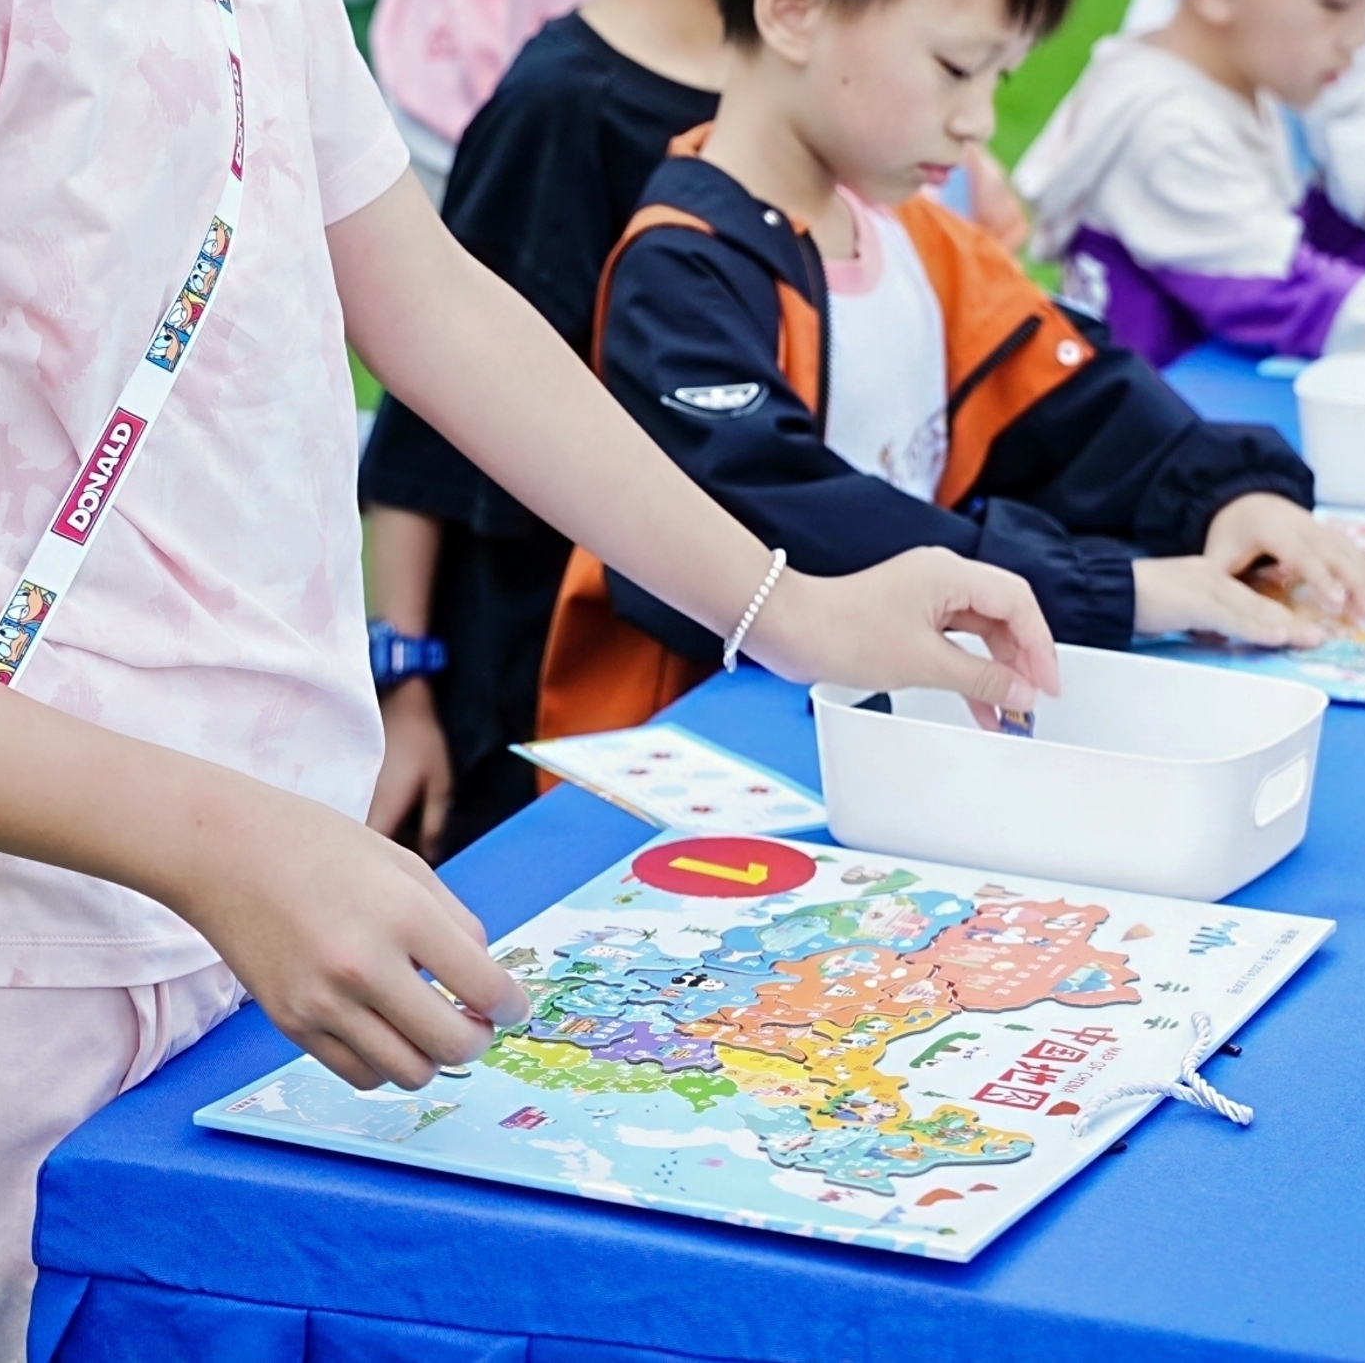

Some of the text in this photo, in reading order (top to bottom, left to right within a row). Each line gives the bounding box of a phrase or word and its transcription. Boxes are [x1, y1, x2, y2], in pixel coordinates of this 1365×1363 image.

[67, 422, 134, 533] DONALD
[969, 1027, 1119, 1110] 中国地图
[1059, 1046, 1123, 1093] MAP OF CHINA
